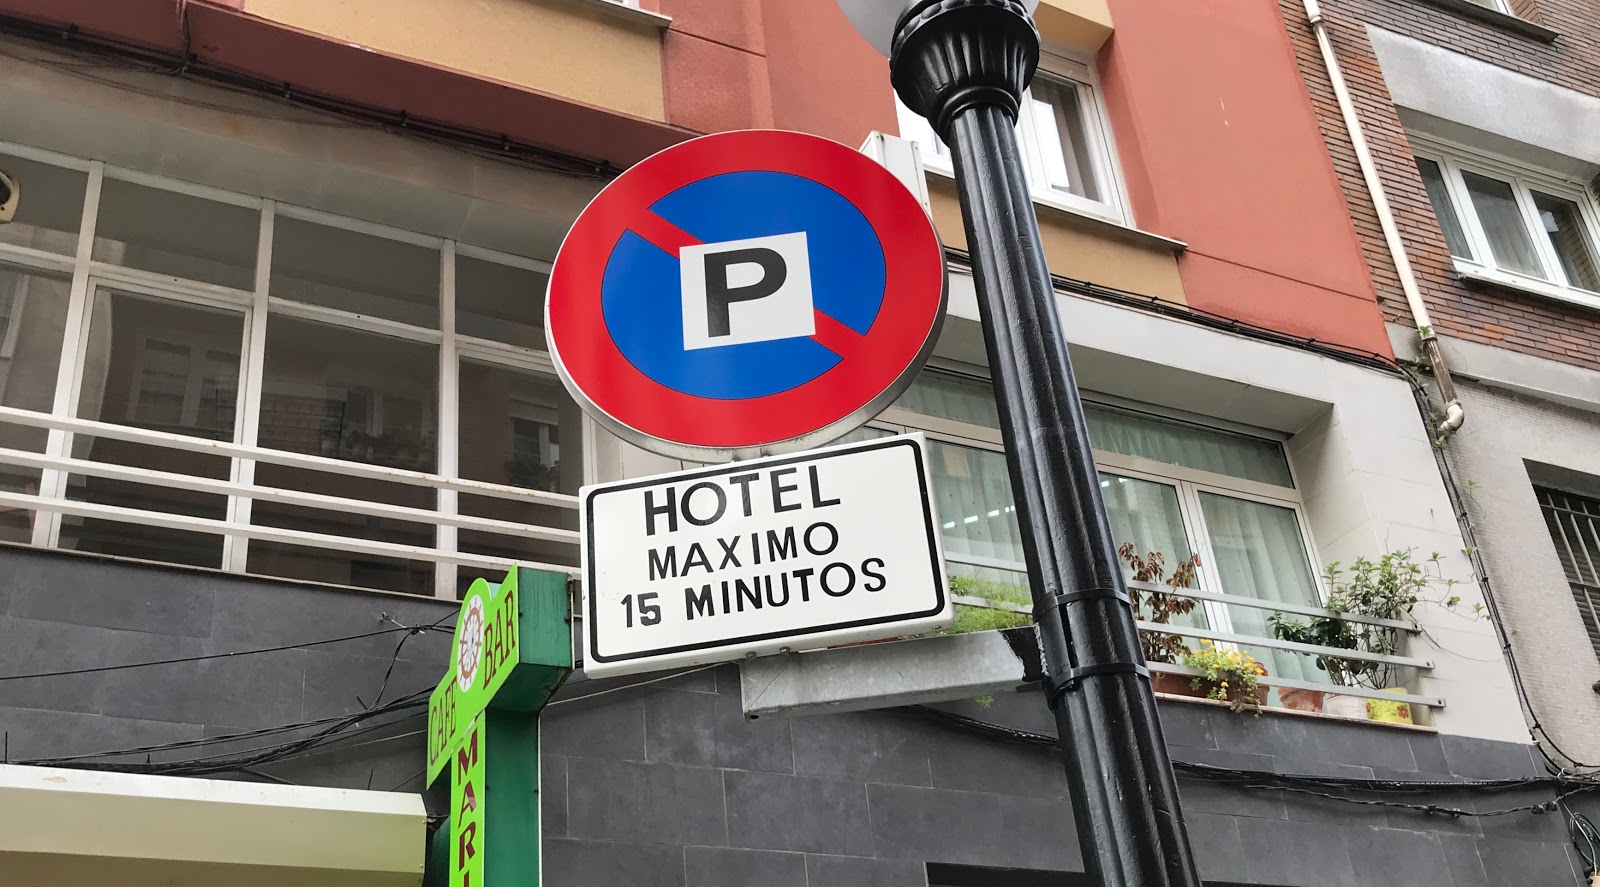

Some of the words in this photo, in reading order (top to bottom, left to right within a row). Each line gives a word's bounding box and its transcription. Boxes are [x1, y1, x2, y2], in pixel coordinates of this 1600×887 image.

[703, 247, 787, 339] P
[644, 465, 840, 536] HOTEL
[648, 521, 839, 581] MAXIMO
[620, 592, 662, 628] 15
[685, 557, 886, 620] MINUTOS
[429, 675, 457, 766] CAFE
[483, 589, 516, 690] BAR
